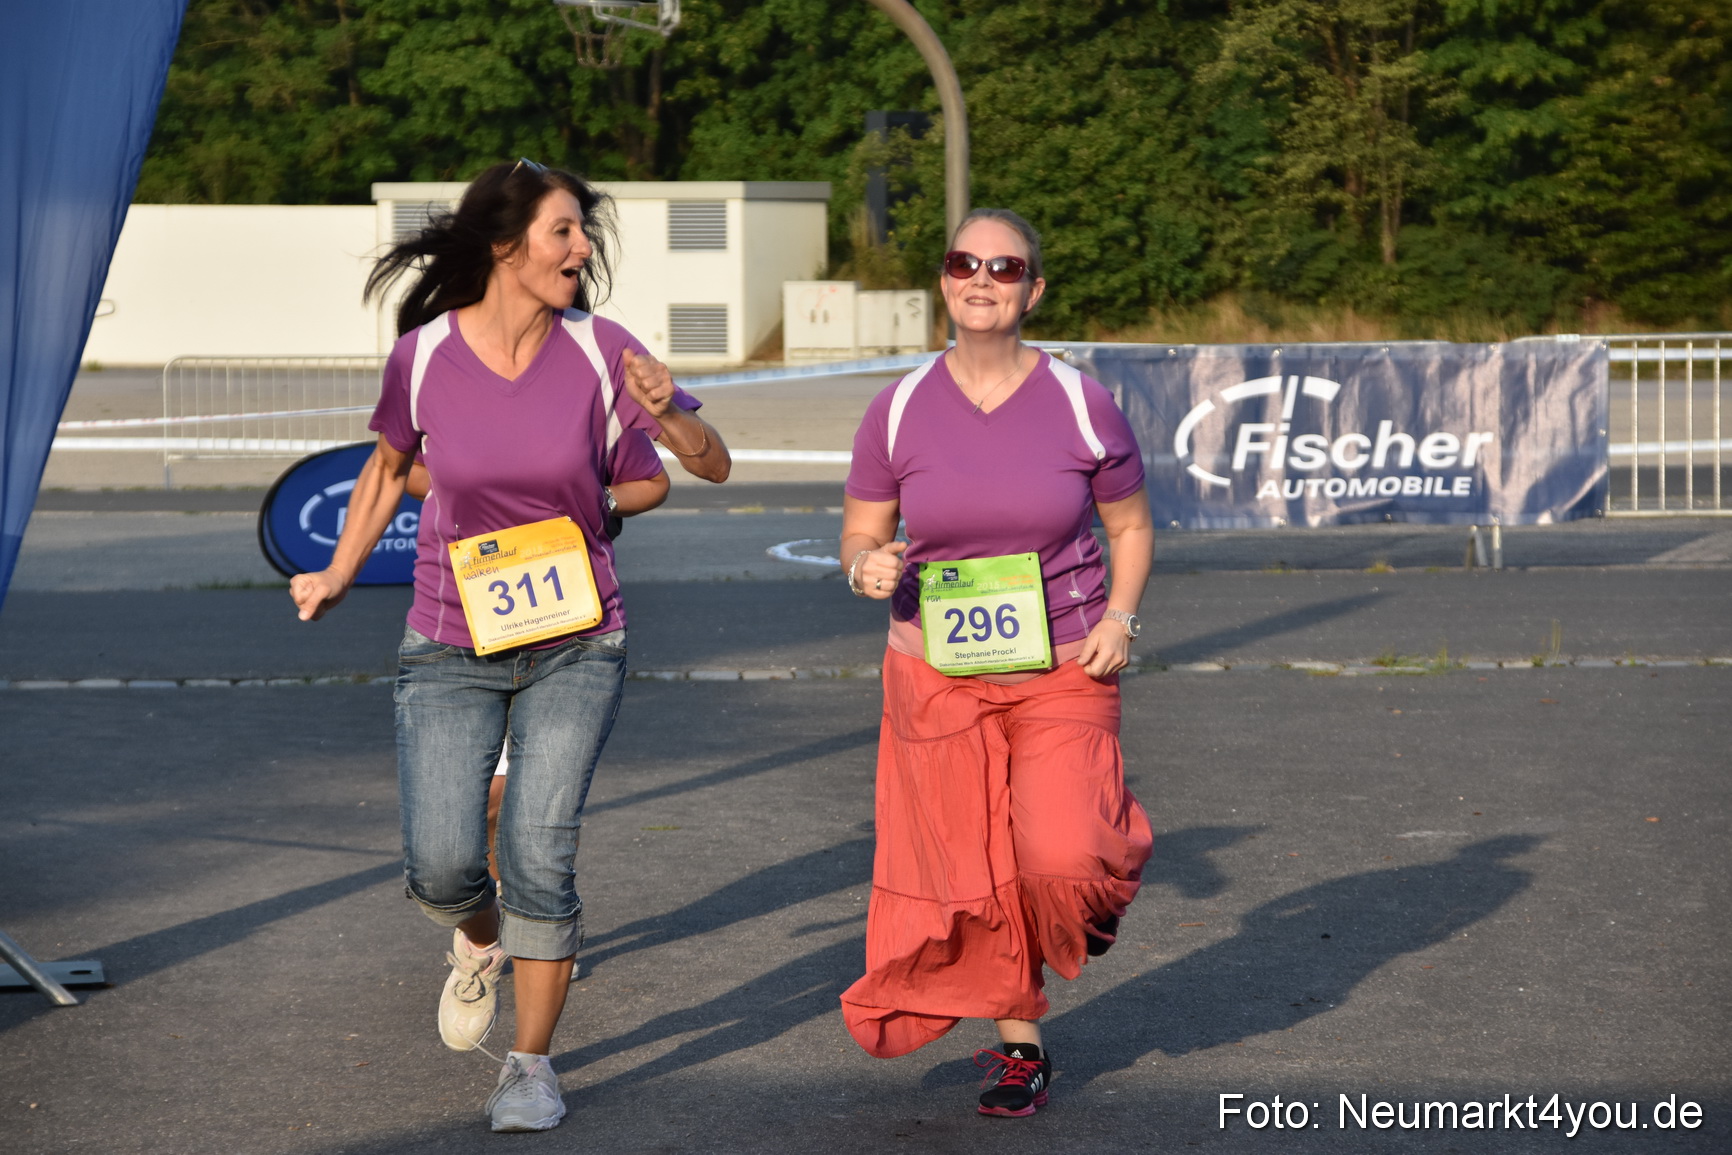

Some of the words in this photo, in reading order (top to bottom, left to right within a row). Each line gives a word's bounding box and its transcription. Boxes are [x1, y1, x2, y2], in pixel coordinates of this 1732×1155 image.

[1232, 420, 1494, 471] Fischer
[1256, 476, 1472, 500] AUTOMOBILE
[472, 547, 517, 565] firmenlauf
[488, 565, 564, 616] 311
[935, 578, 974, 589] firmenlauf
[500, 620, 524, 632] Ulrike
[524, 609, 571, 626] Hagenreiner
[944, 603, 1020, 644] 296
[954, 649, 991, 660] Stephanie
[992, 647, 1017, 656] Prockl
